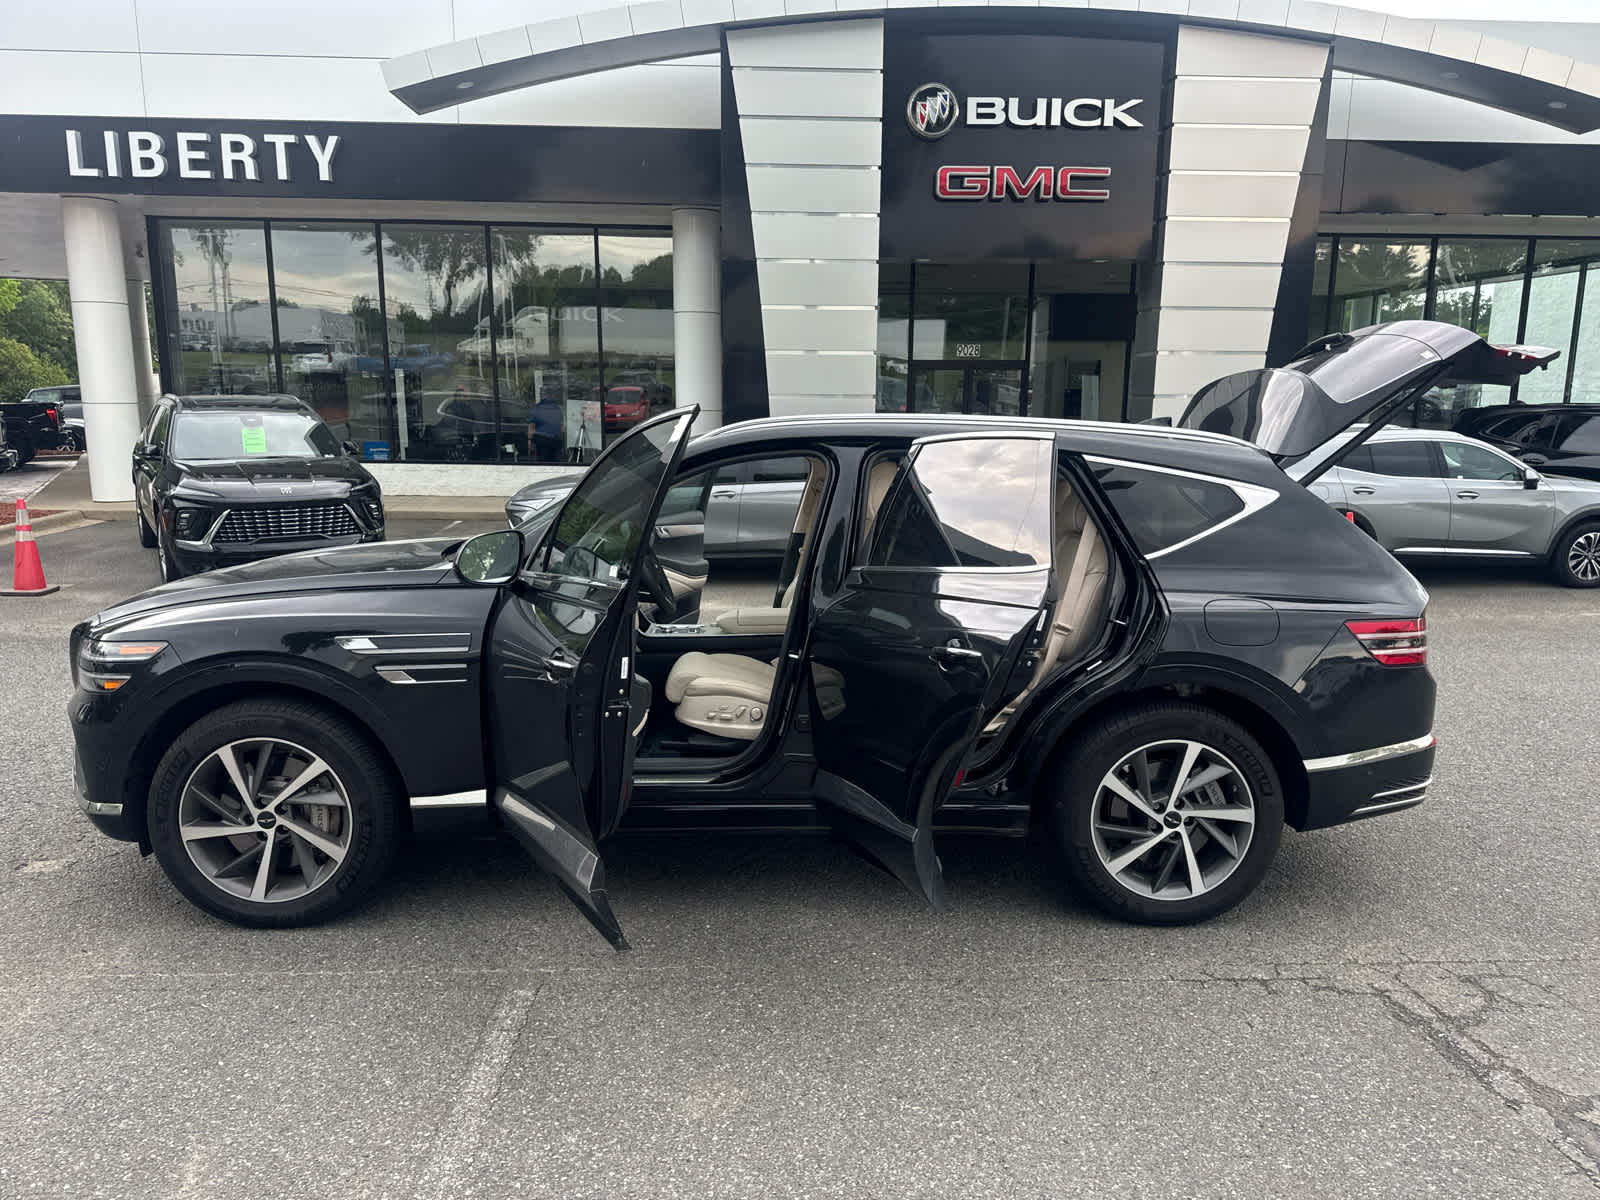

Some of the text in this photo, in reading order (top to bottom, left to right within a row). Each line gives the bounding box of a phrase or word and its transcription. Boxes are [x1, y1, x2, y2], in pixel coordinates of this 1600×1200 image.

[965, 96, 1145, 128] BUICK
[65, 129, 341, 181] LIBERTY
[936, 165, 1112, 200] GMC
